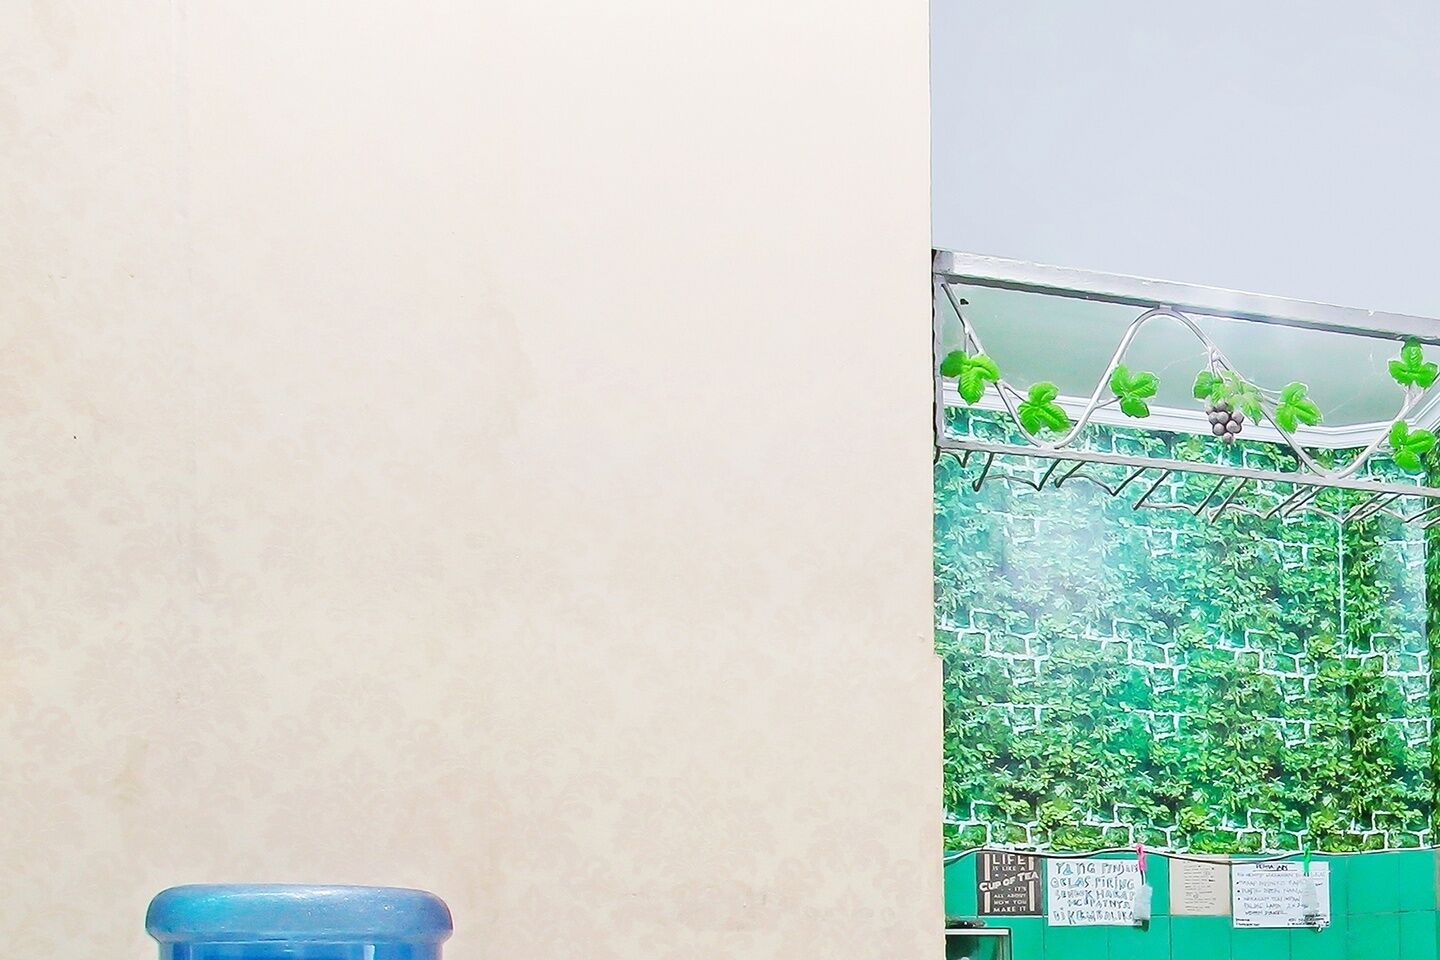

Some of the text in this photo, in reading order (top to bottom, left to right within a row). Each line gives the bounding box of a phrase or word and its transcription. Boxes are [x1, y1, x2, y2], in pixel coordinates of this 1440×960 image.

[992, 853, 1026, 865] LIFE
[979, 871, 1039, 892] CUP OF TEA
